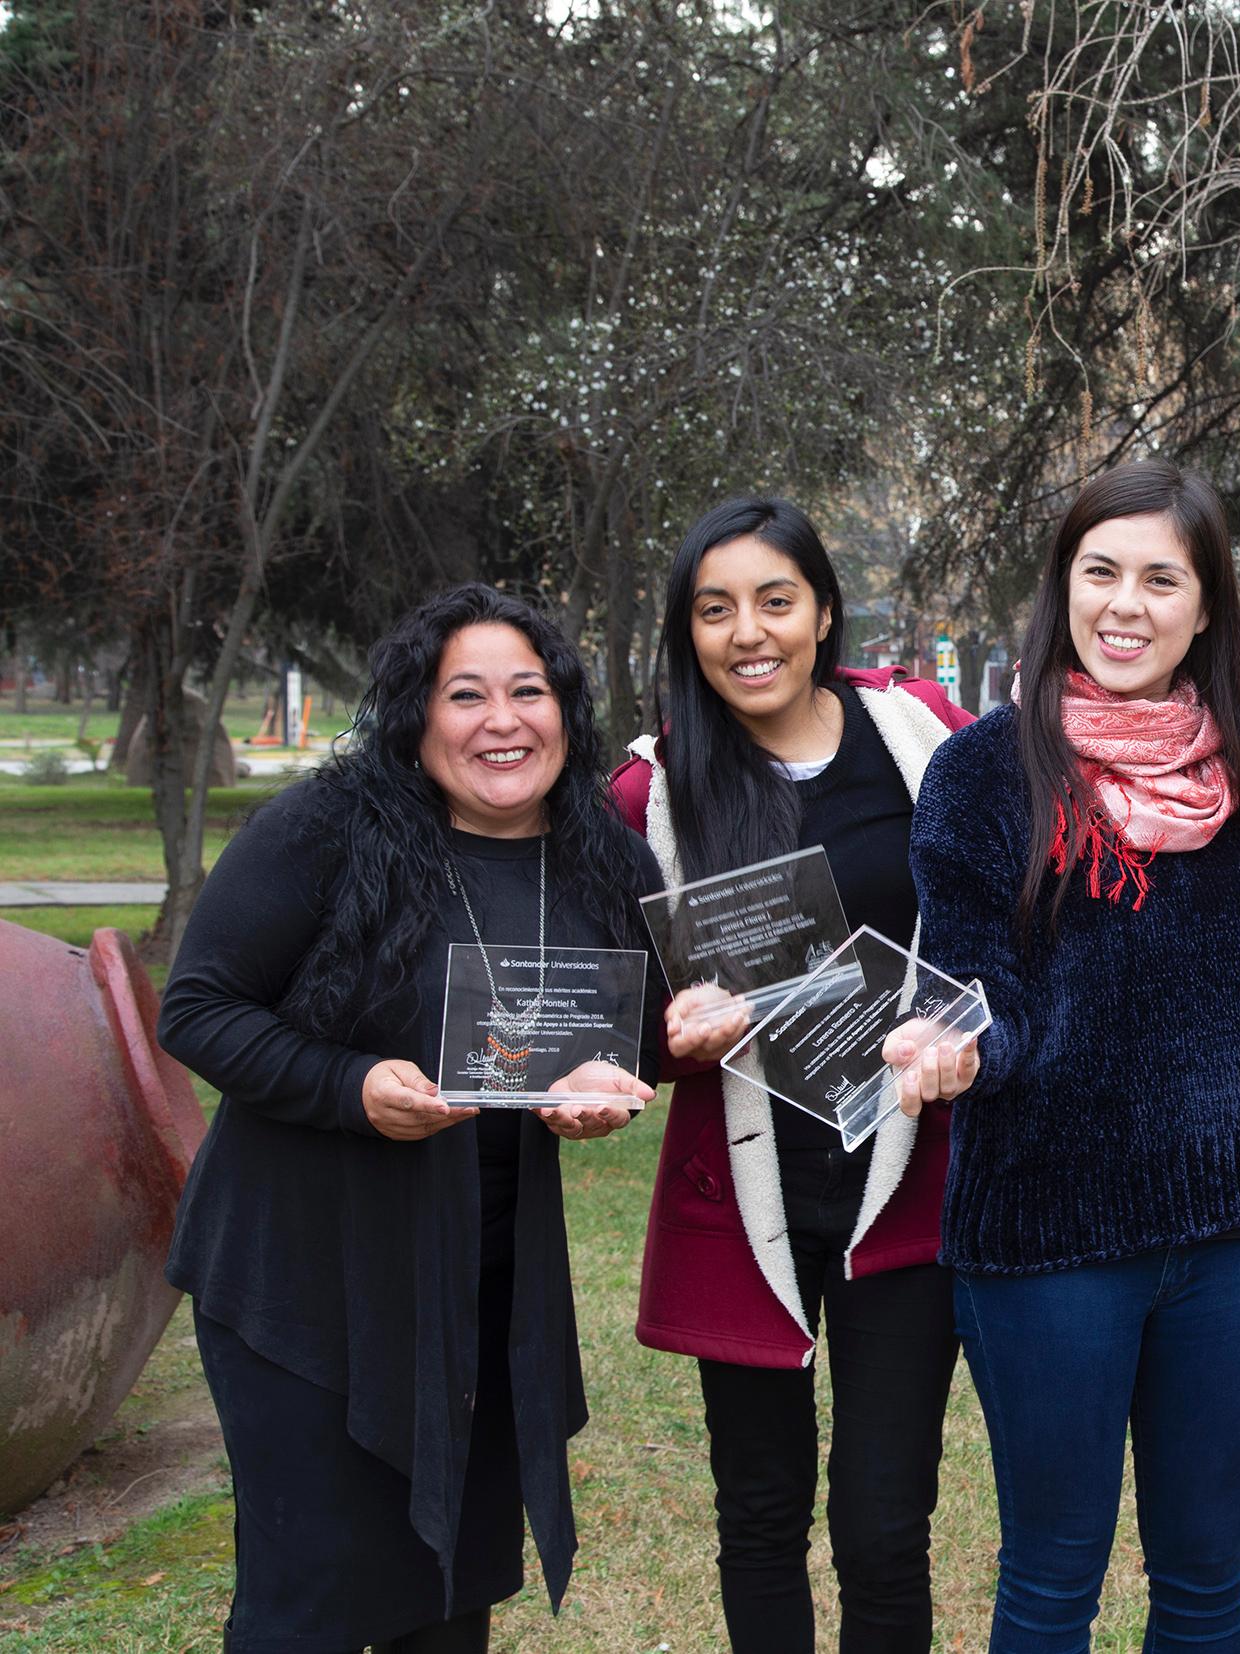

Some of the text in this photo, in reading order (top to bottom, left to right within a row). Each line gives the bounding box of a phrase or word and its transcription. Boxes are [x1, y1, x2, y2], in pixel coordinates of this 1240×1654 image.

[510, 959, 599, 970] Santander Universidades
[541, 999, 569, 1007] Montiel
[570, 1000, 577, 1008] R.
[774, 1004, 807, 1036] Santander
[812, 1026, 834, 1048] Lorena
[830, 1006, 856, 1030] Romero
